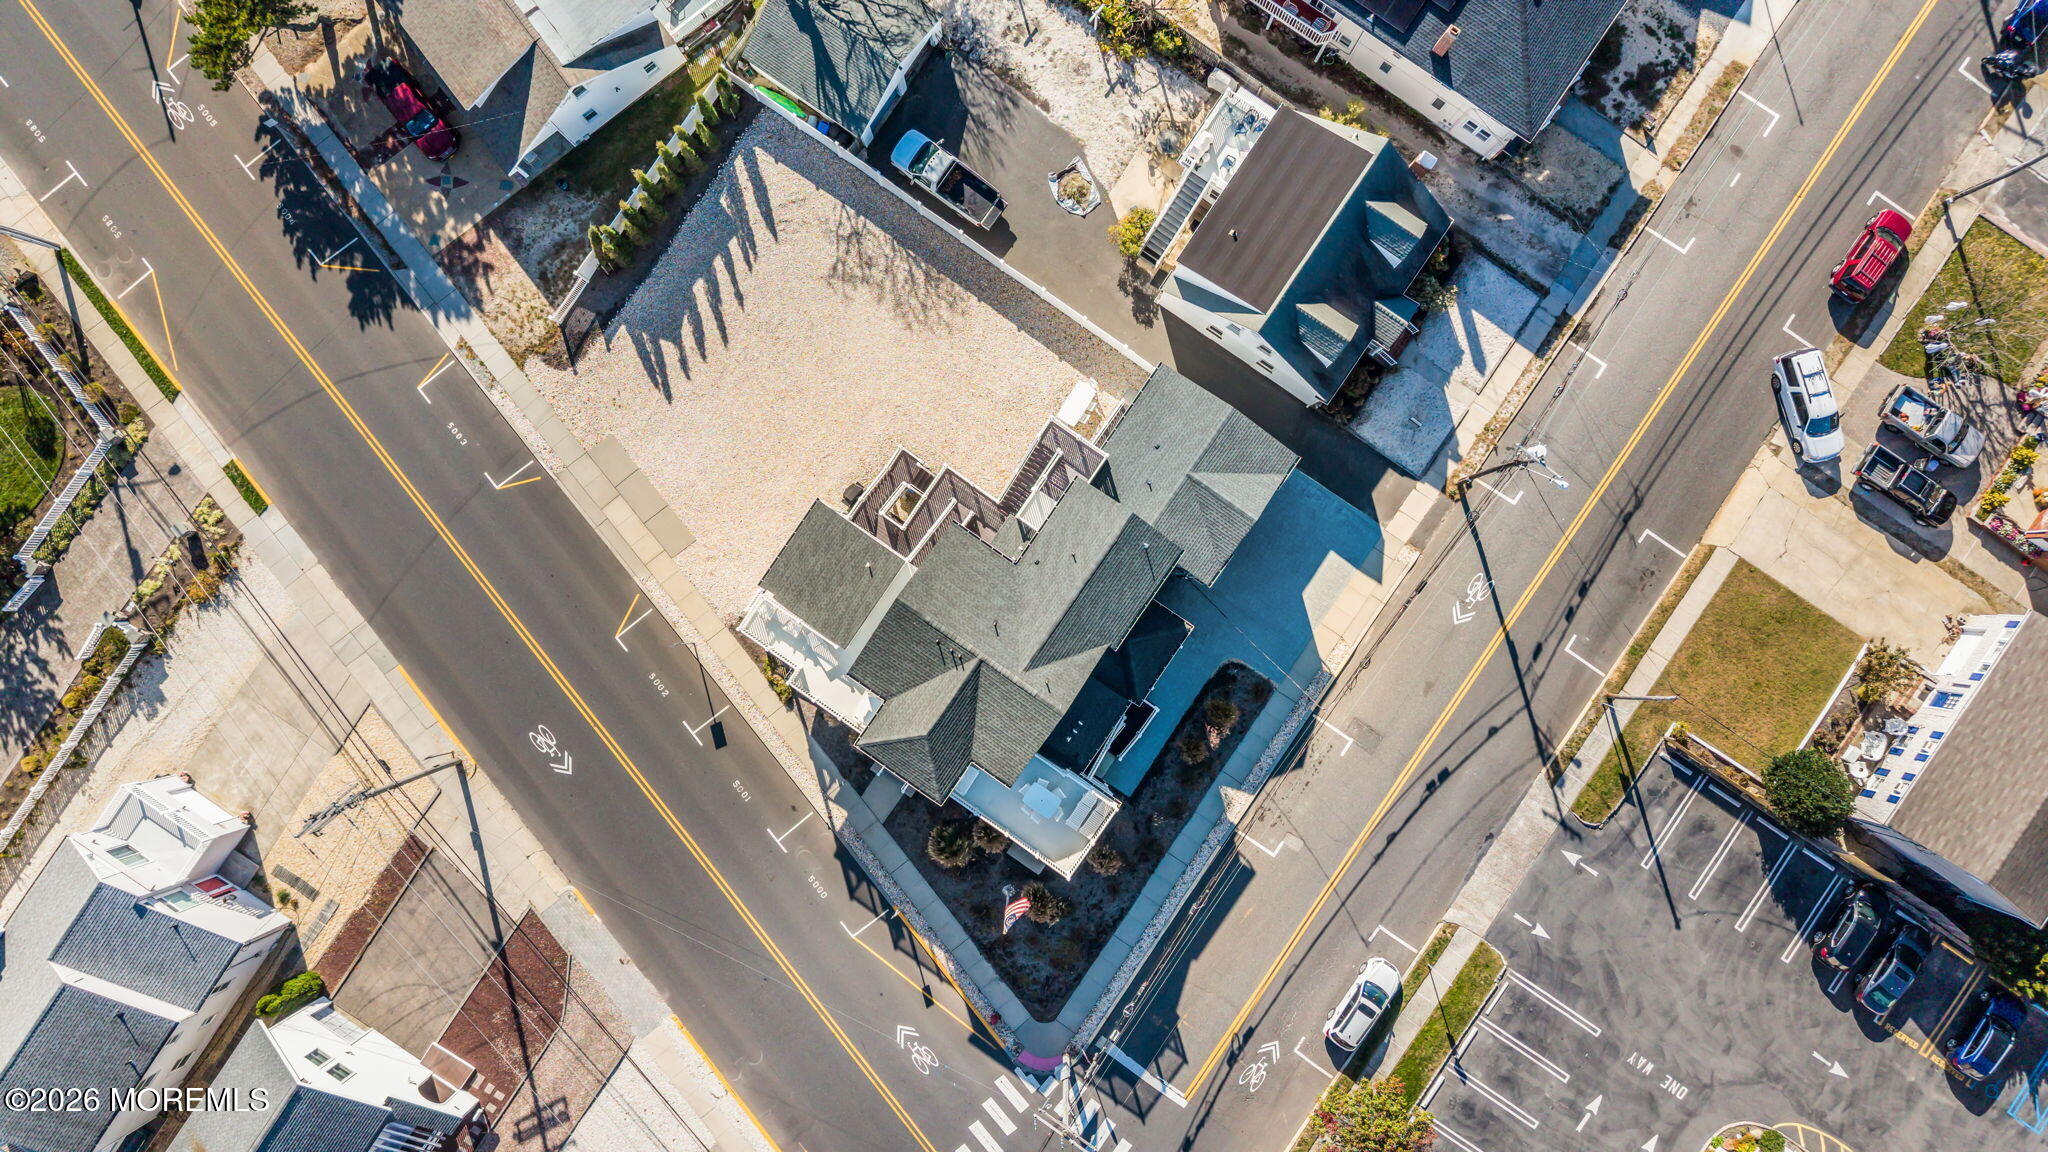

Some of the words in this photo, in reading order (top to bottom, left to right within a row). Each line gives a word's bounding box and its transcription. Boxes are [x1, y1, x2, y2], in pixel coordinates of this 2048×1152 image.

[197, 103, 218, 127] 5005
[447, 422, 468, 446] 5003
[648, 672, 670, 697] 5002
[732, 779, 752, 803] 5001
[807, 875, 828, 899] 5000
[1884, 1023, 1919, 1050] RESERVED
[1626, 1052, 1654, 1076] WAY
[1659, 1074, 1688, 1100] ONE
